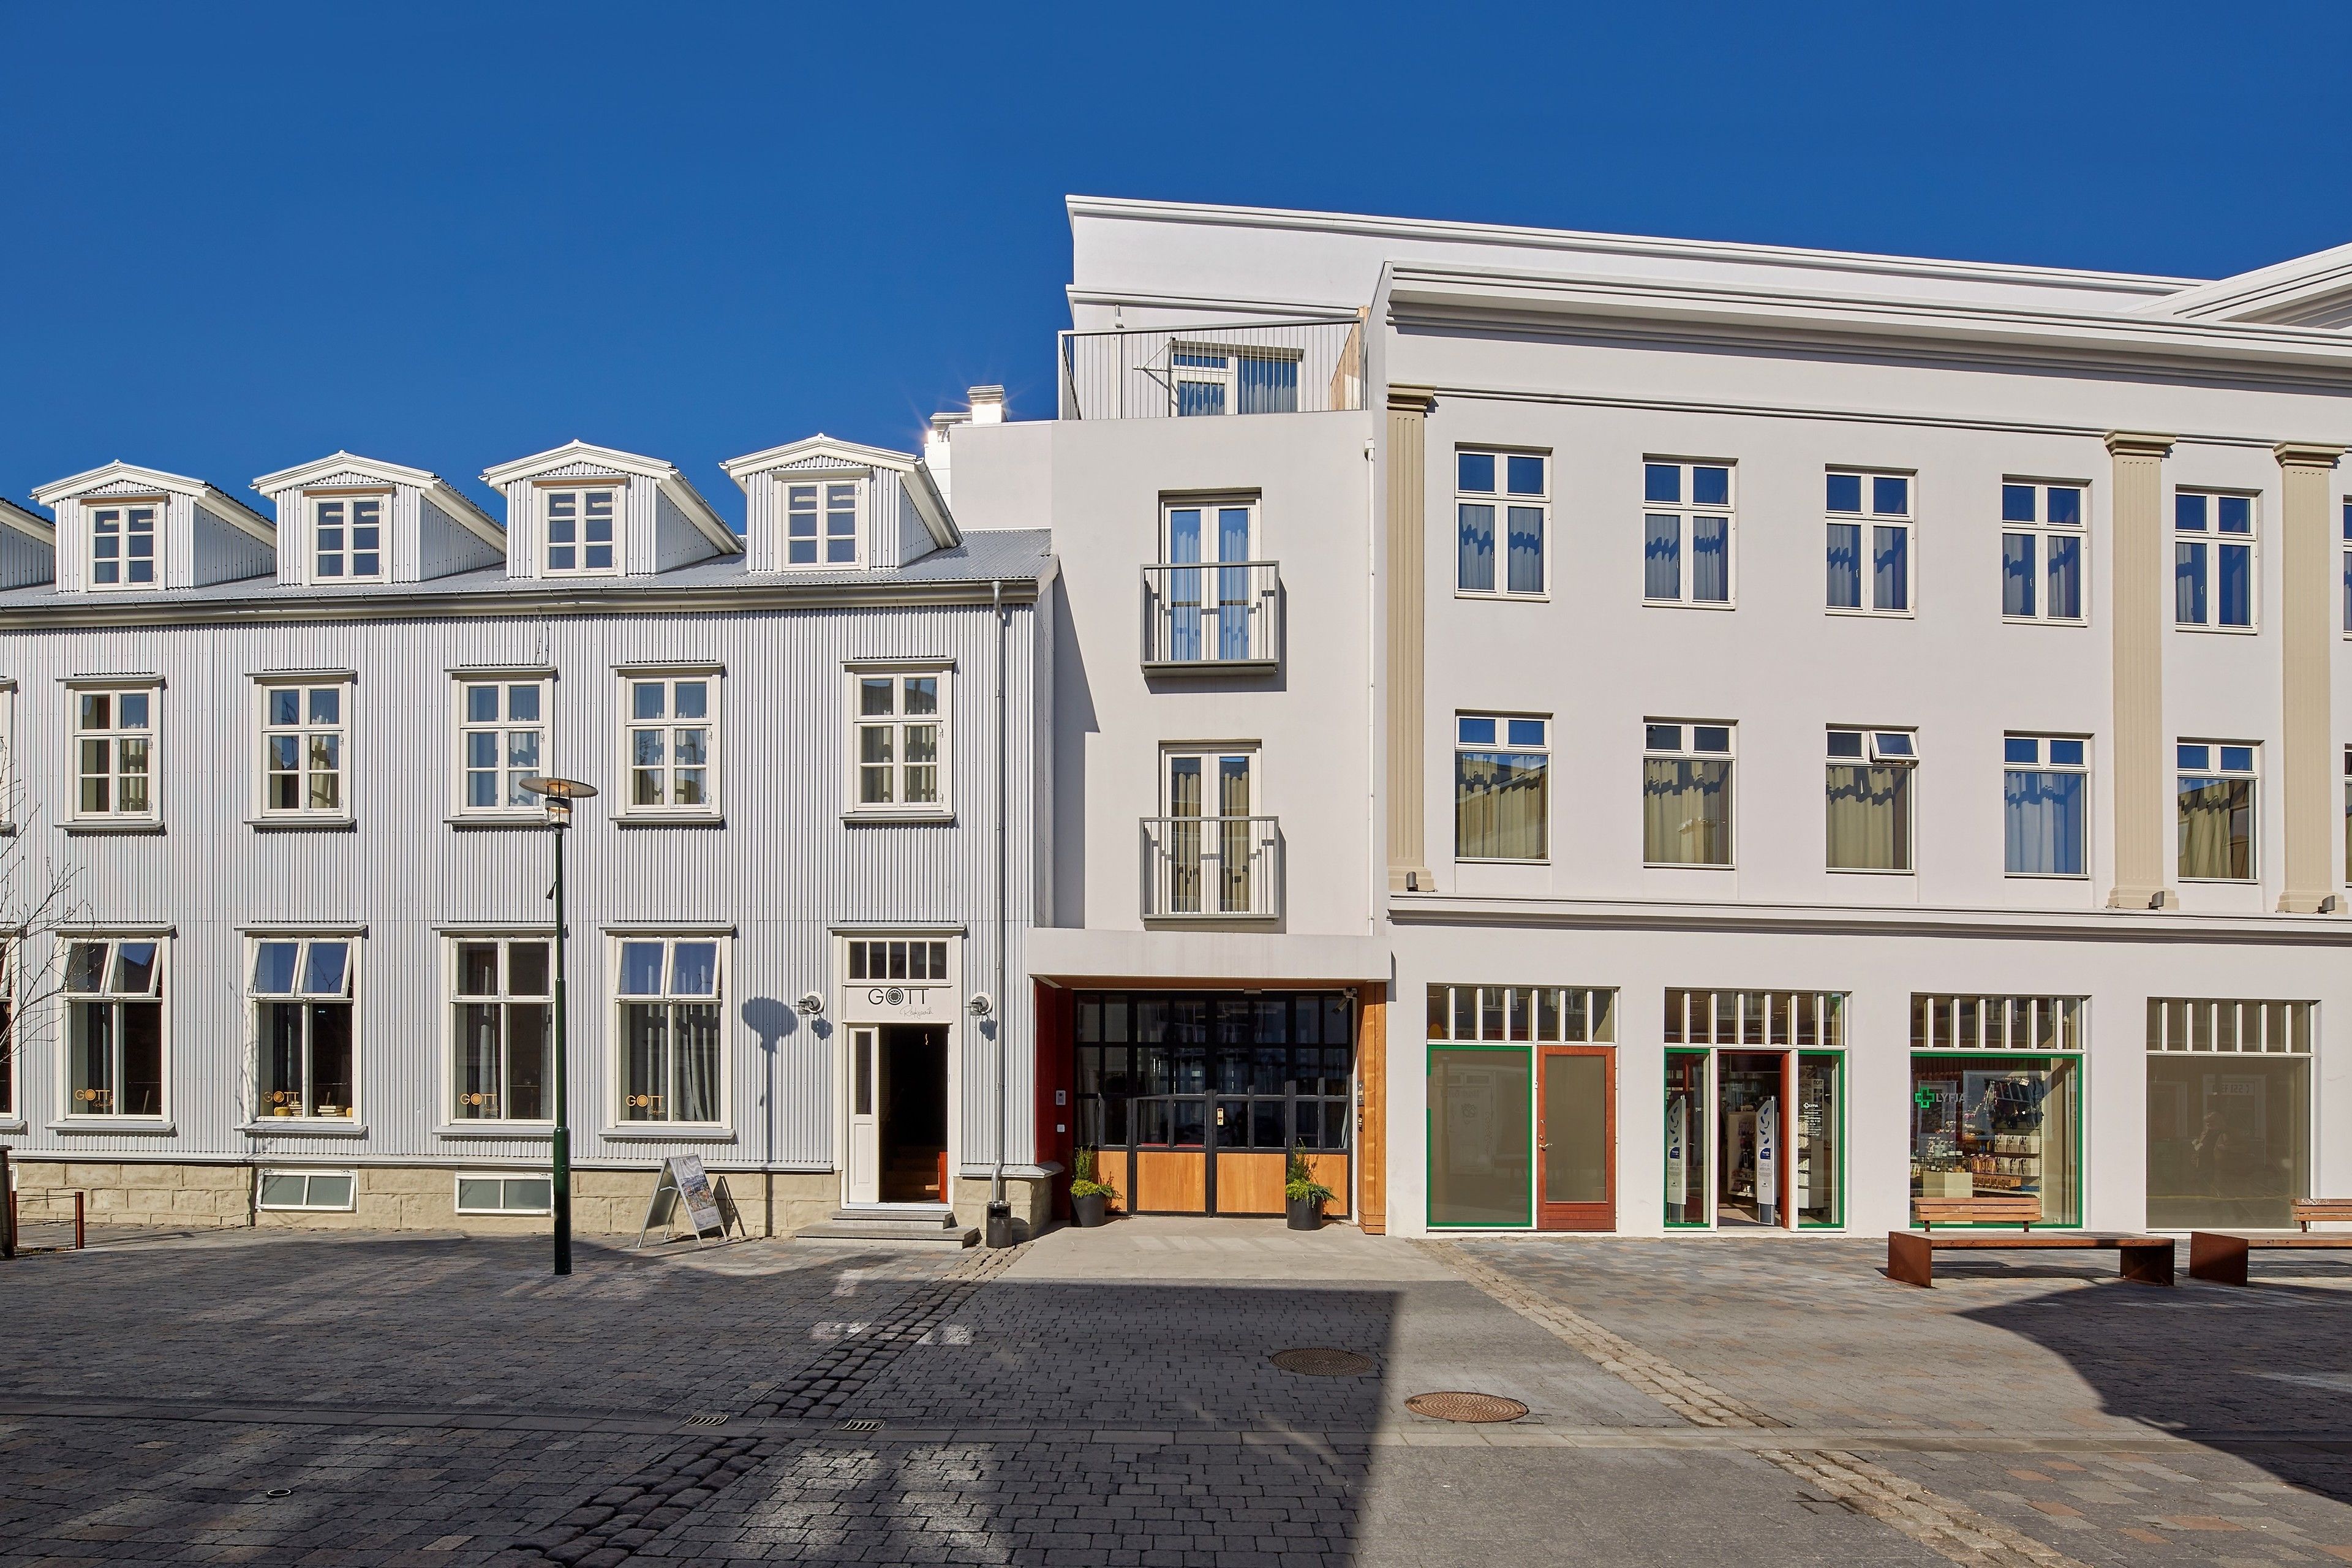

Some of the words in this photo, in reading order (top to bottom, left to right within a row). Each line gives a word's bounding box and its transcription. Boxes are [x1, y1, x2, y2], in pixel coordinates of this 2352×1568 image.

[868, 987, 929, 1005] GOTT
[75, 1089, 110, 1101] GOTT
[460, 1093, 497, 1105] GOTT
[625, 1095, 664, 1107] GOTT
[1936, 1093, 1966, 1102] LYFJA
